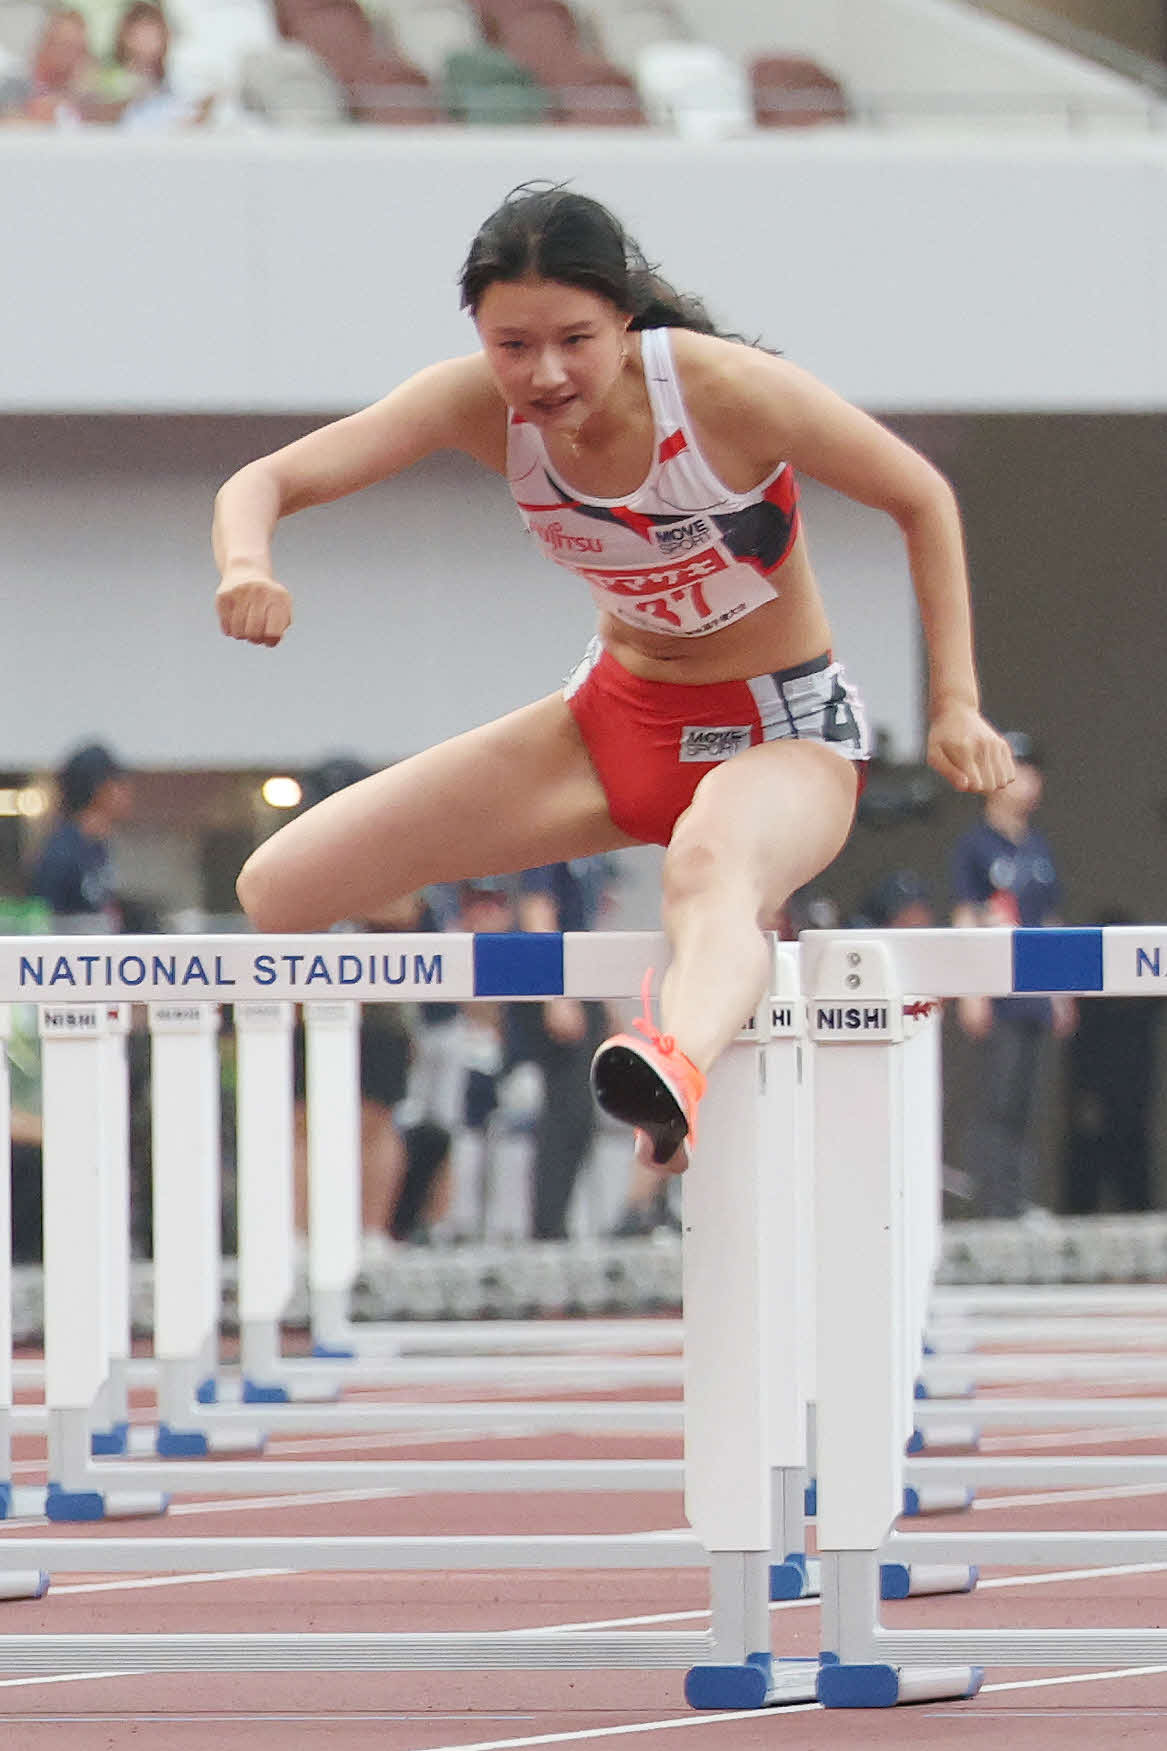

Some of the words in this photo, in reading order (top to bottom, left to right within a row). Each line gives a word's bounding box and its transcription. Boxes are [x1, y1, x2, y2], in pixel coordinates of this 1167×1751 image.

[655, 519, 707, 542] MOVE
[20, 956, 235, 986] NATIONAL
[254, 955, 442, 985] STADIUM
[1136, 948, 1167, 976] N
[817, 1008, 888, 1030] NISHI
